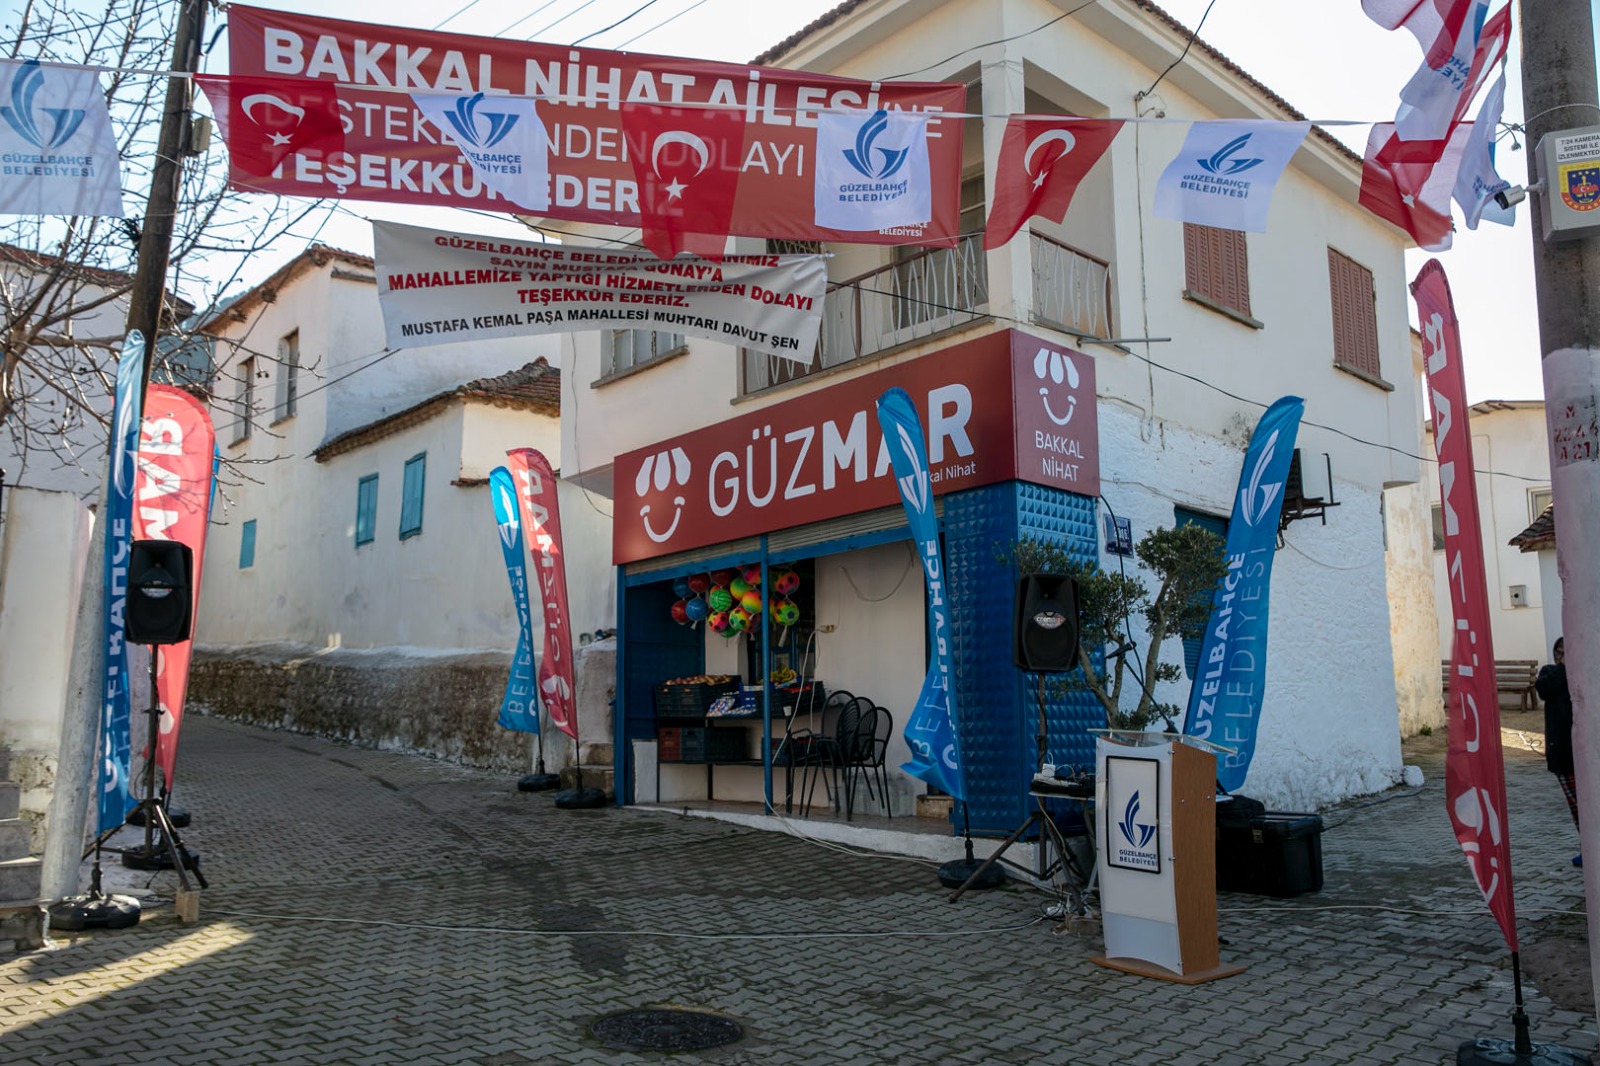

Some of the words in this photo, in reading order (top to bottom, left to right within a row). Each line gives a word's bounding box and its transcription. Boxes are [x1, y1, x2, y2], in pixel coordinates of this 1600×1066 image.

[264, 26, 510, 95] BAKKAL
[525, 50, 696, 117] NİHAT
[703, 70, 944, 138] AİLEİ'E
[2, 152, 94, 168] GÜZELBAHÇE
[468, 151, 521, 165] ELBAHÇE
[3, 165, 95, 177] BELEDİYESİ
[262, 144, 502, 200] TEŞEKKÜ
[545, 172, 685, 217] DERİZ
[839, 180, 908, 193] GÜZELBAHÇE
[839, 187, 907, 202] BELEDİYESİ
[1180, 181, 1249, 199] BELEDİYESİ
[879, 227, 923, 237] BELEDİYESİ
[434, 235, 564, 261] GÜZELBAHÇE
[490, 256, 546, 270] SAYIN
[388, 267, 522, 291] MAHALLEMİZE
[528, 270, 600, 286] YAPTIĞI
[606, 272, 746, 297] HİZMETLERDEN
[750, 285, 814, 311] DOLAYI
[517, 288, 613, 306] TEŞEKKÜR
[619, 290, 690, 308] EDERİZ.
[401, 319, 470, 337] MUSTAFA
[473, 313, 523, 330] KEMAL
[527, 310, 563, 326] PAŞA
[567, 308, 649, 321] MAHALLESİ
[653, 311, 718, 331] MUHTARI
[722, 322, 768, 344] DAVUT
[771, 335, 799, 350] ŞEN
[1035, 430, 1085, 459] BAKKAL
[945, 460, 976, 479] Nihat
[1042, 455, 1079, 482] NİHAT
[1190, 552, 1246, 740] ÜZELBAHÇE
[1225, 547, 1267, 768] BELEDİYESİ
[1119, 848, 1157, 860] GÜZELBAHÇE
[1119, 856, 1158, 867] BELEDİYESİ
